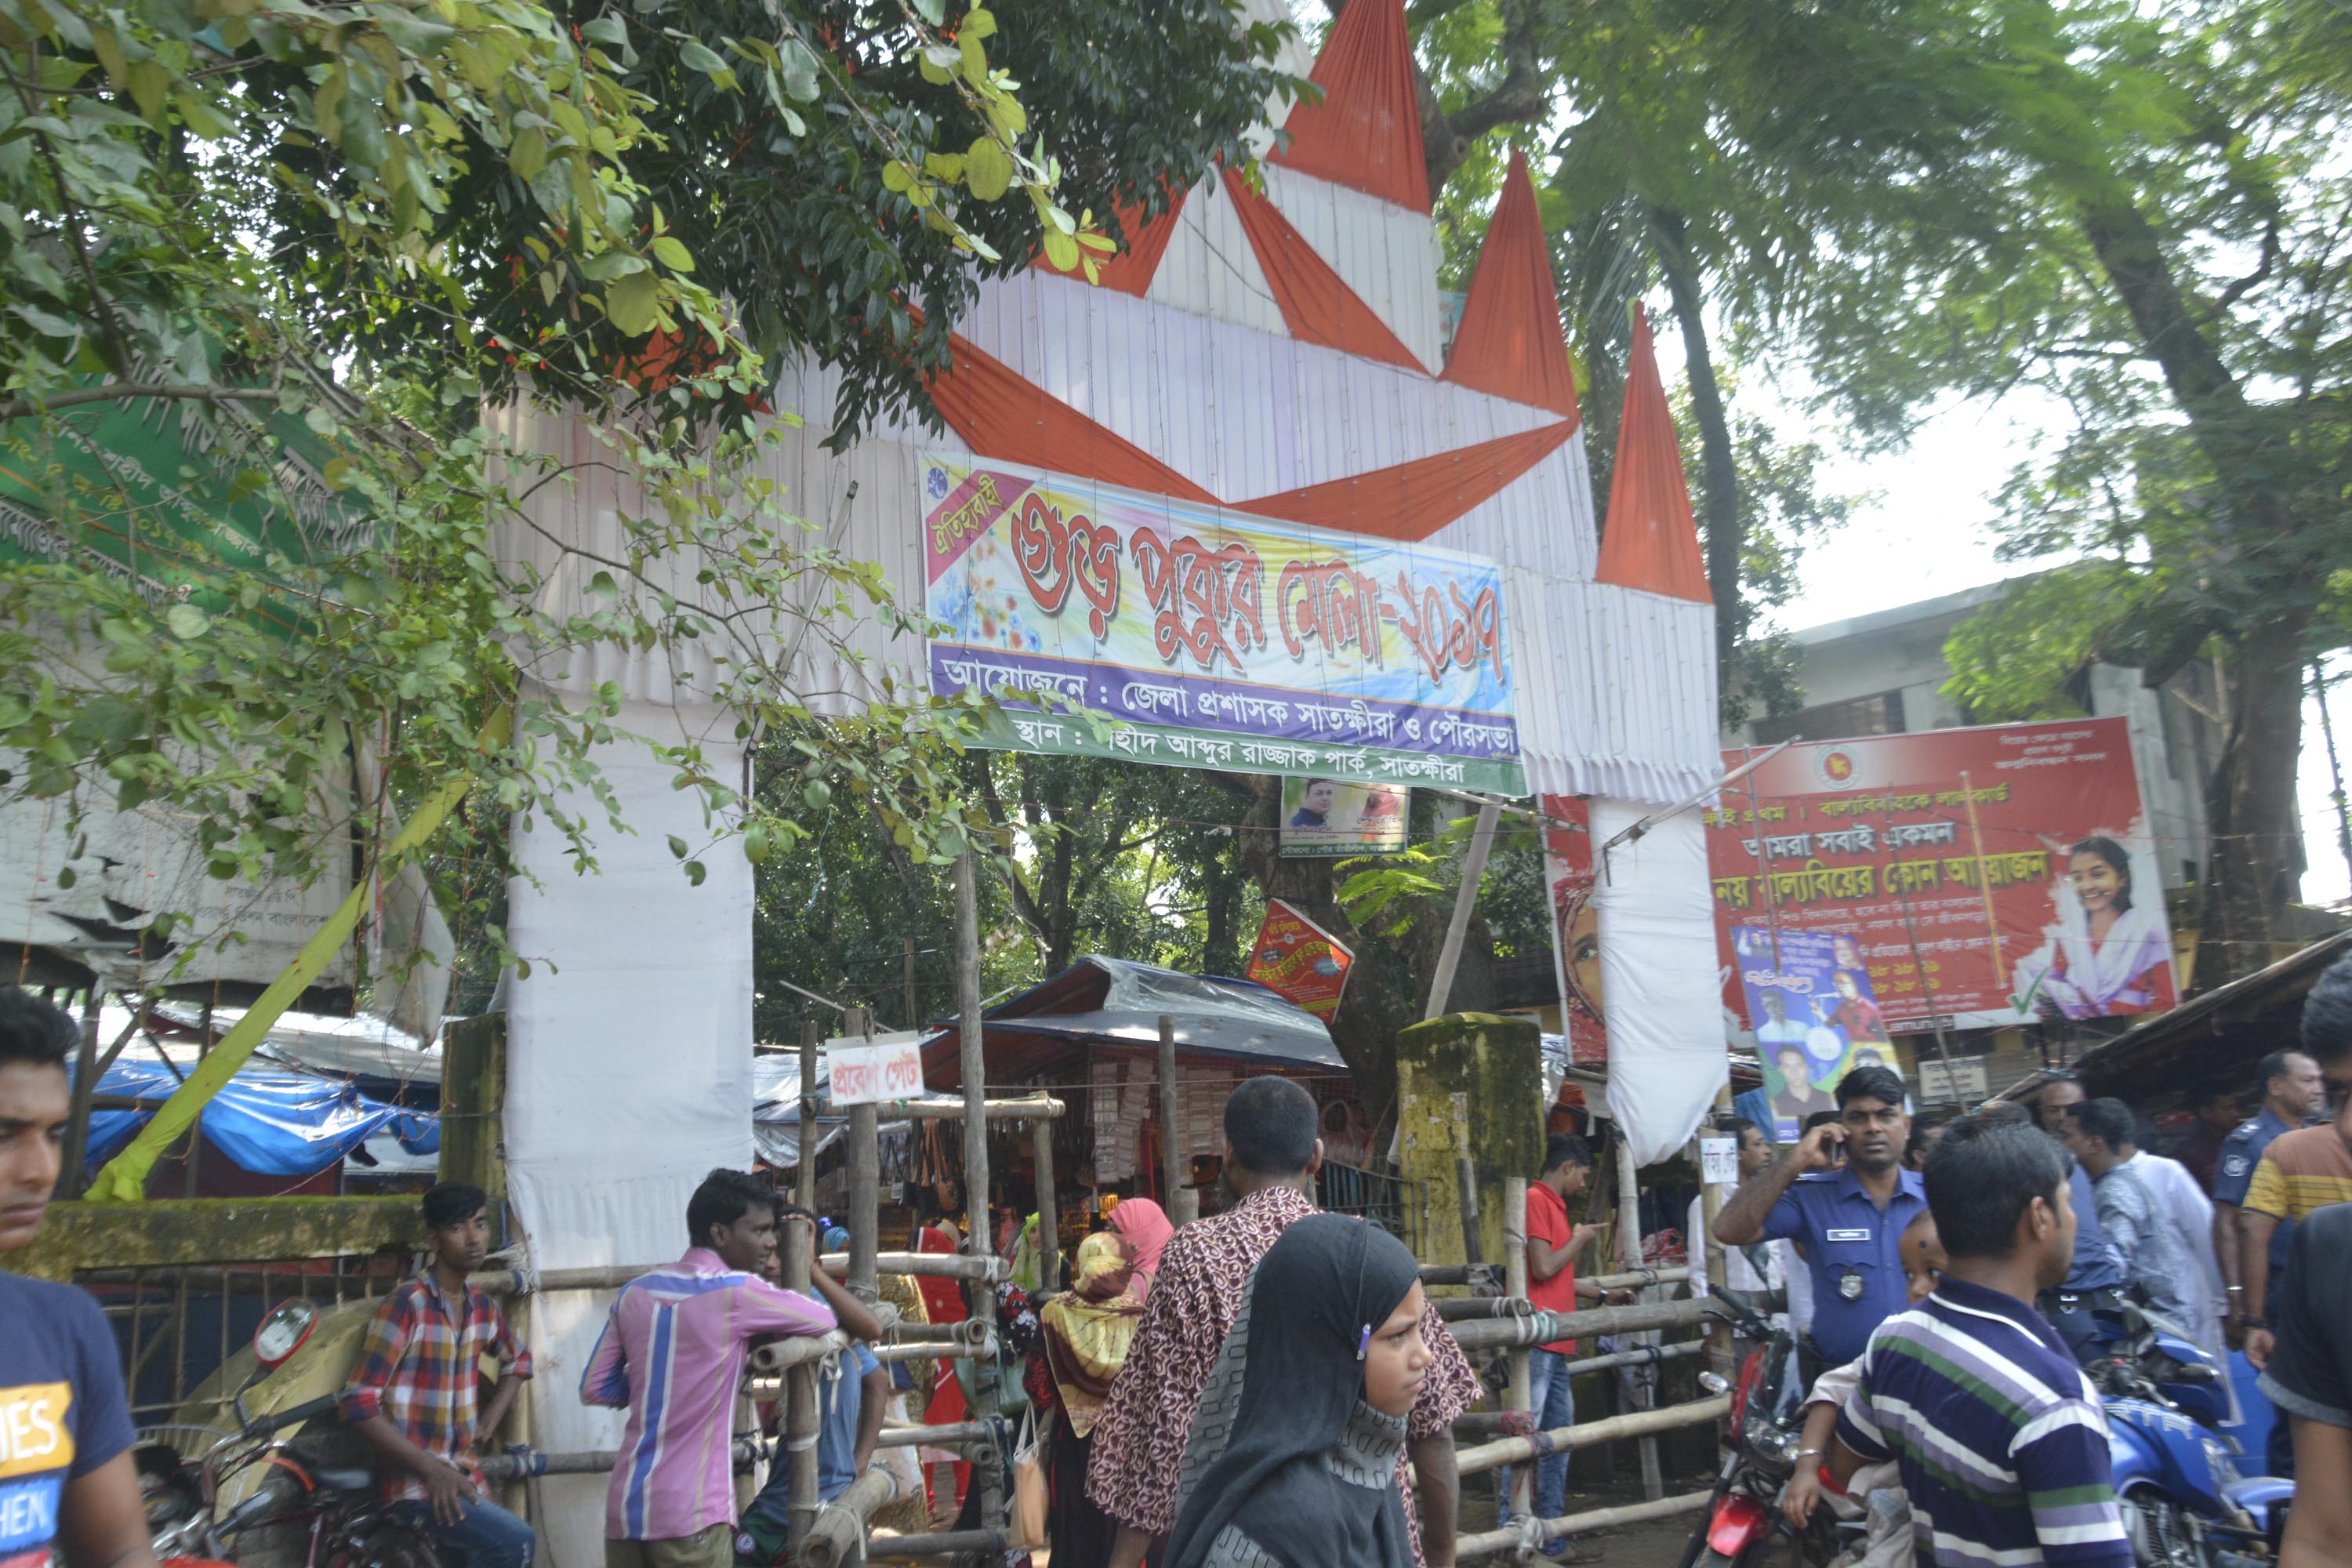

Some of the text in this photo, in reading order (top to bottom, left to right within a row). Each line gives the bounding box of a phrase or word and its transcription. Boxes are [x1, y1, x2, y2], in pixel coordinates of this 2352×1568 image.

[929, 474, 1004, 556] ঐতিহ্যবাহী
[1011, 492, 1121, 640] গুড়
[1129, 526, 1267, 673] পুকুর
[940, 659, 1088, 706] আয়োজনে
[1122, 681, 1191, 717] জেলা
[1197, 689, 1290, 728] প্রশাসক
[1294, 699, 1396, 740] সাতক্ষীরা
[1403, 718, 1421, 741] ও
[1429, 711, 1515, 753] পৌরসভা
[1011, 719, 1065, 750] স্থান
[1108, 722, 1160, 757] হীদ
[1165, 734, 1235, 767] আব্দুর
[1241, 741, 1318, 770] রাজ্জাক
[1379, 754, 1465, 784] সাতক্ষীরা
[1740, 833, 1810, 860] আমরা
[1814, 822, 1878, 853] সবাই
[0, 1398, 59, 1463] ES
